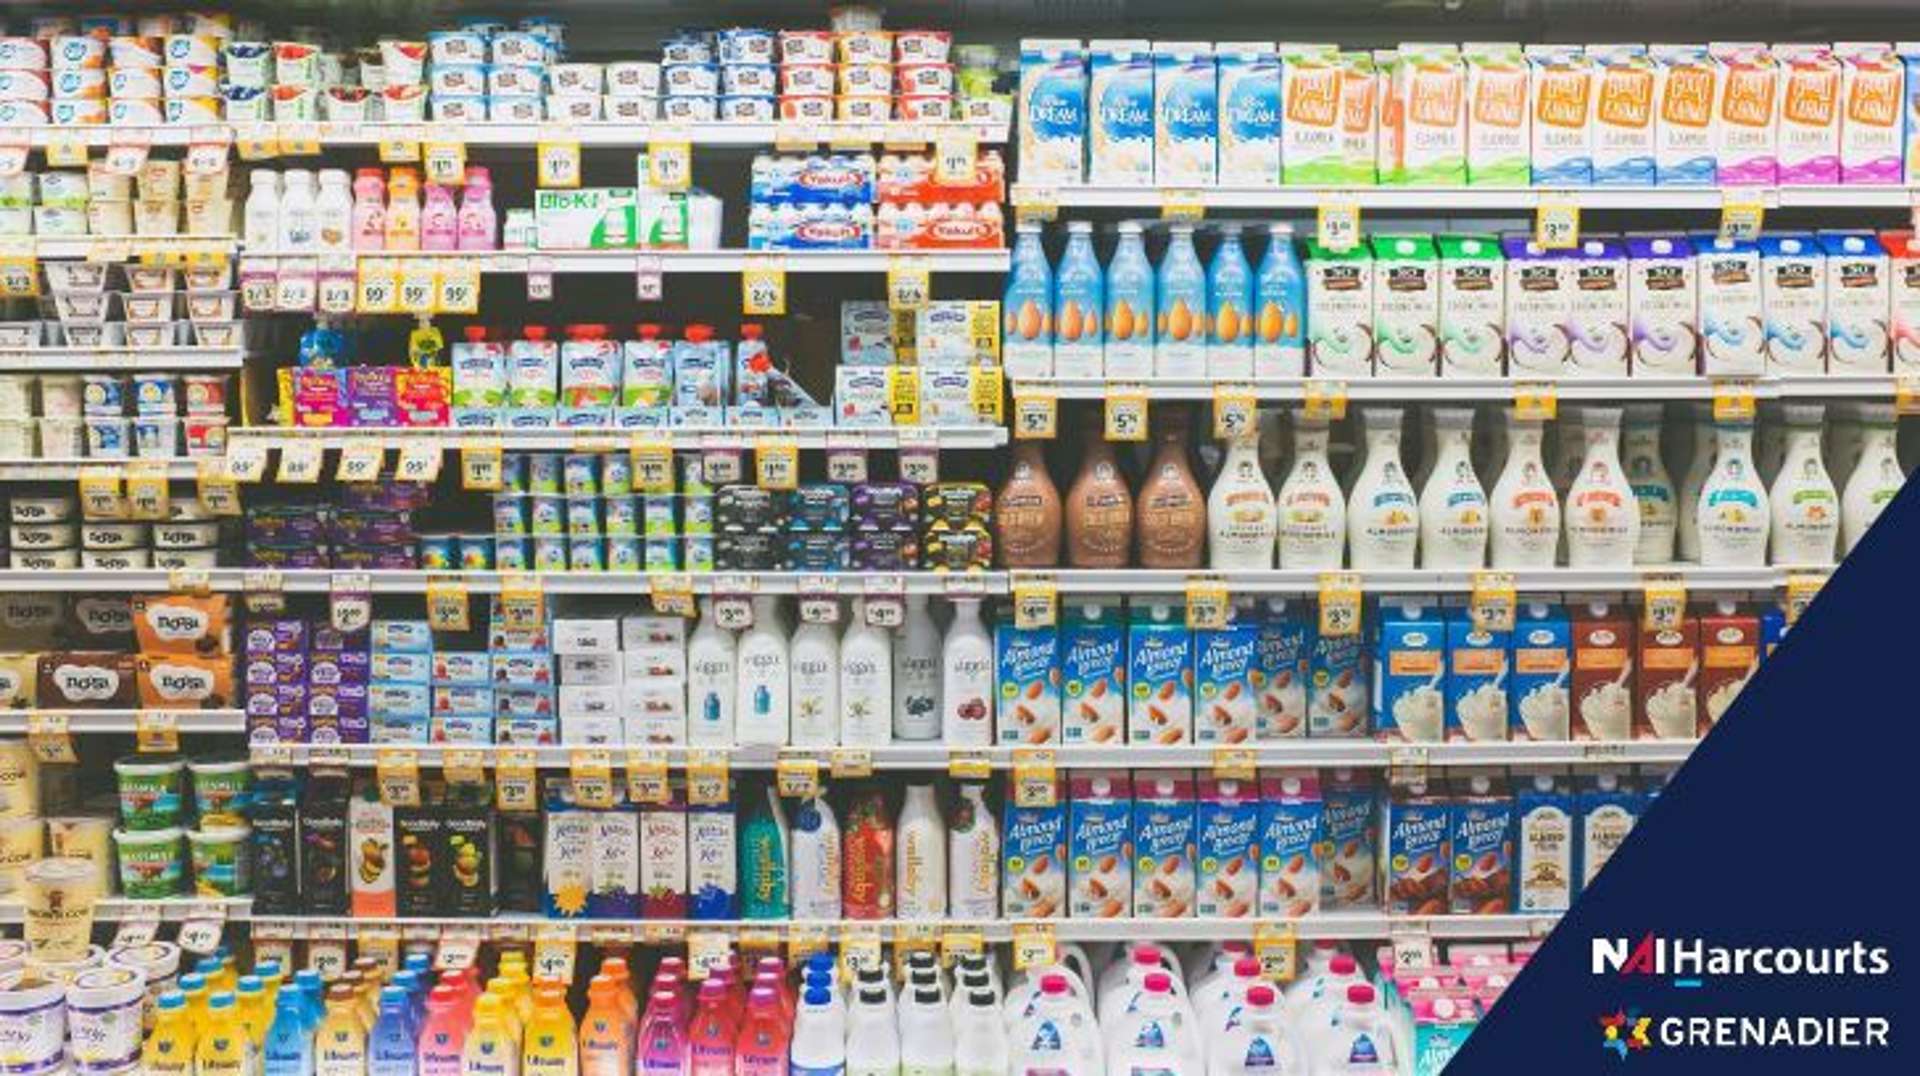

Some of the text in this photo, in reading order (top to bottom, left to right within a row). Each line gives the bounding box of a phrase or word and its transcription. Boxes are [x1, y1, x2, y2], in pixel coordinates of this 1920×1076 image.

[1030, 105, 1078, 123] DREAM
[157, 615, 200, 631] noosa
[1134, 640, 1188, 667] Almond
[1200, 641, 1254, 667] Almond
[1265, 815, 1318, 840] Almond
[1392, 812, 1447, 840] Almond
[1455, 811, 1510, 840] Almond
